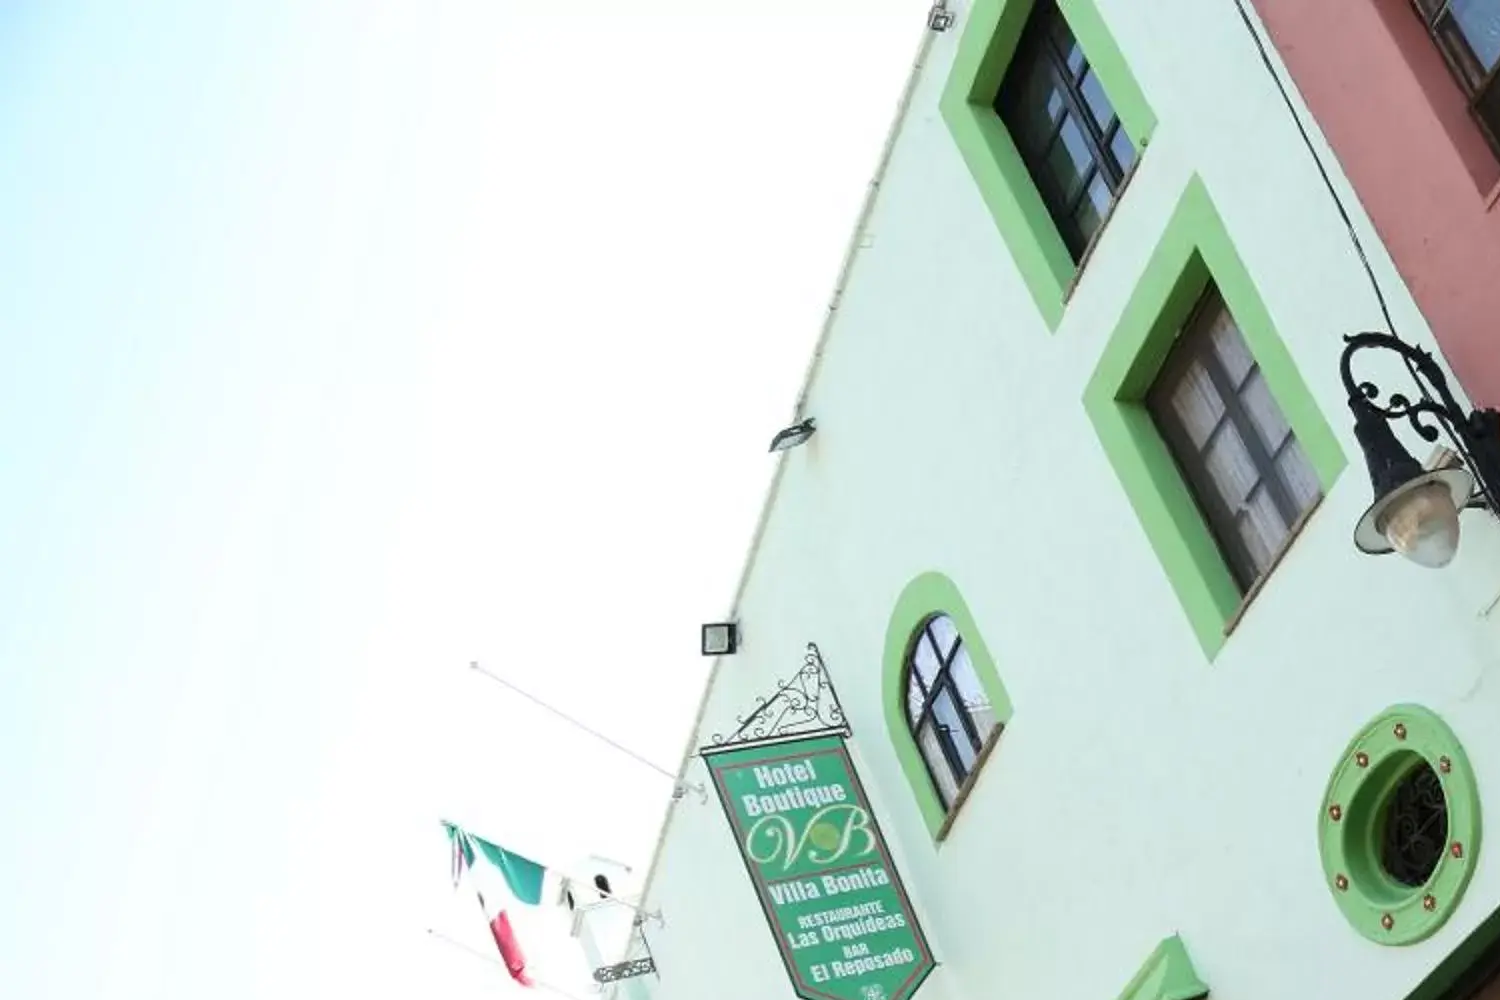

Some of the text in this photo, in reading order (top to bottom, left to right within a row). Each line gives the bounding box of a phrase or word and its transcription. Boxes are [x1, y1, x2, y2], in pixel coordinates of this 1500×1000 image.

[753, 759, 817, 789] Hotel
[742, 783, 847, 817] Boutique
[768, 867, 889, 905] Villa Bonita
[797, 900, 885, 929] RESTAURANTE
[787, 931, 819, 949] Las
[842, 943, 869, 959] BAR
[810, 947, 914, 983] El Reposado
